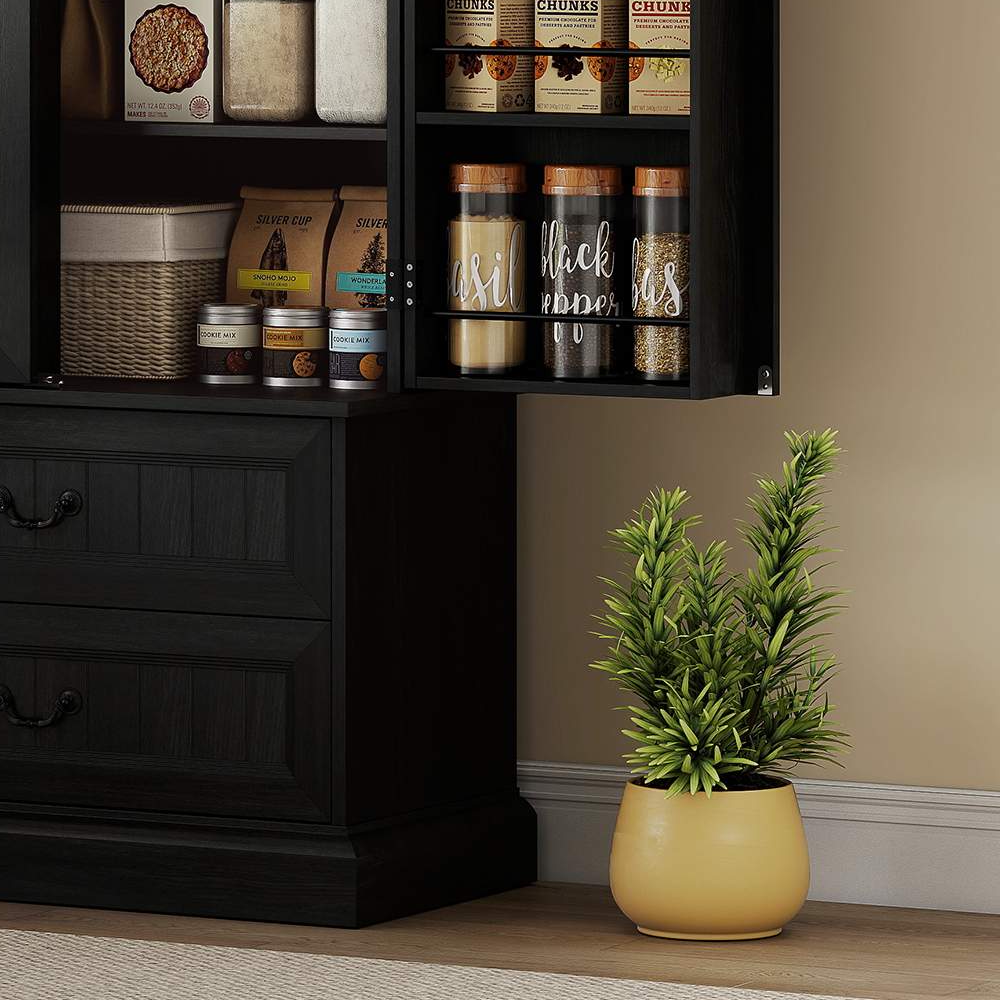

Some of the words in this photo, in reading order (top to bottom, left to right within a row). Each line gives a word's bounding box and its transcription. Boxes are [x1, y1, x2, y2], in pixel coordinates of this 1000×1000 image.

[447, 0, 495, 10] CHUNKS
[537, 0, 599, 11] CHUNKS
[632, 1, 690, 12] CHUNK
[256, 215, 289, 225] SILVER
[291, 216, 312, 226] CUP
[356, 218, 387, 229] SILVER
[632, 237, 690, 317] bas
